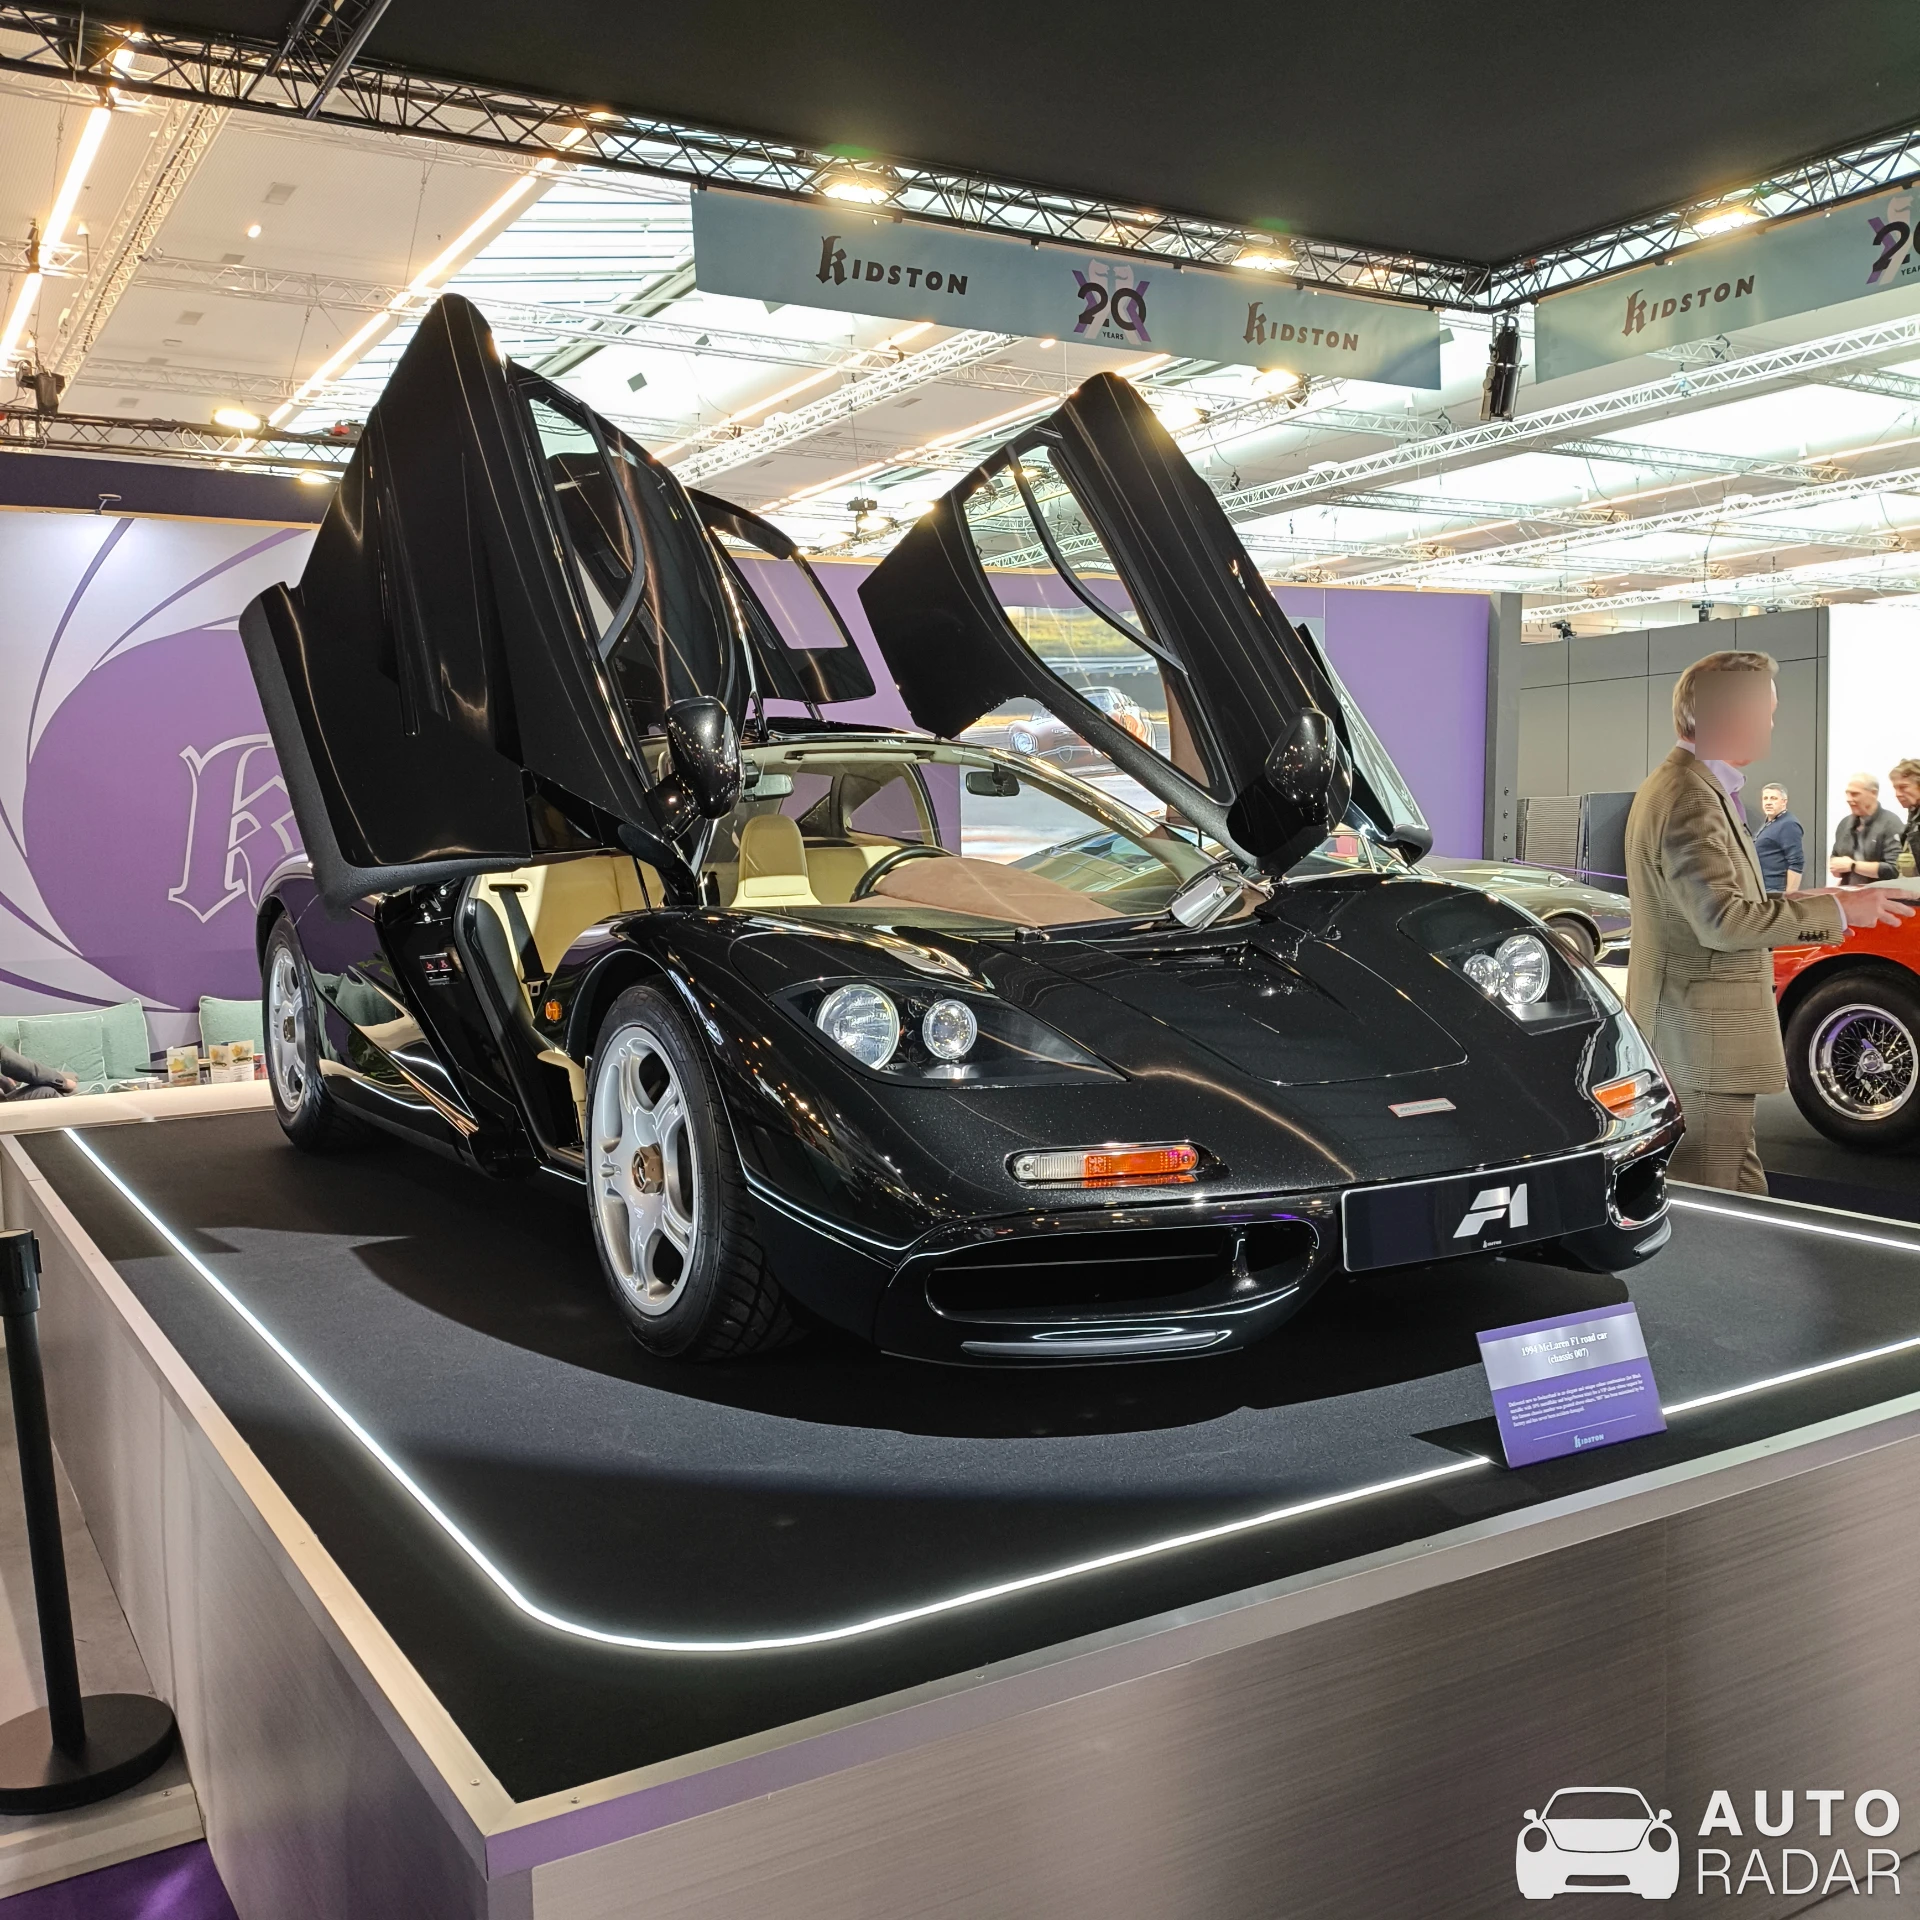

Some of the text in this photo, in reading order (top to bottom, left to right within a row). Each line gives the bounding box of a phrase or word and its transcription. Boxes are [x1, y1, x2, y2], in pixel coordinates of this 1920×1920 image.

[815, 235, 969, 296] KIDSTON
[1872, 221, 1920, 273] 2
[1077, 283, 1147, 331] 20
[1242, 301, 1359, 352] KIDSTON
[1621, 274, 1755, 337] KIDSTON
[1102, 331, 1125, 341] YEARS
[1521, 1332, 1608, 1356] 1994 McLaren F1 road car
[1547, 1347, 1589, 1365] (chassis 007)
